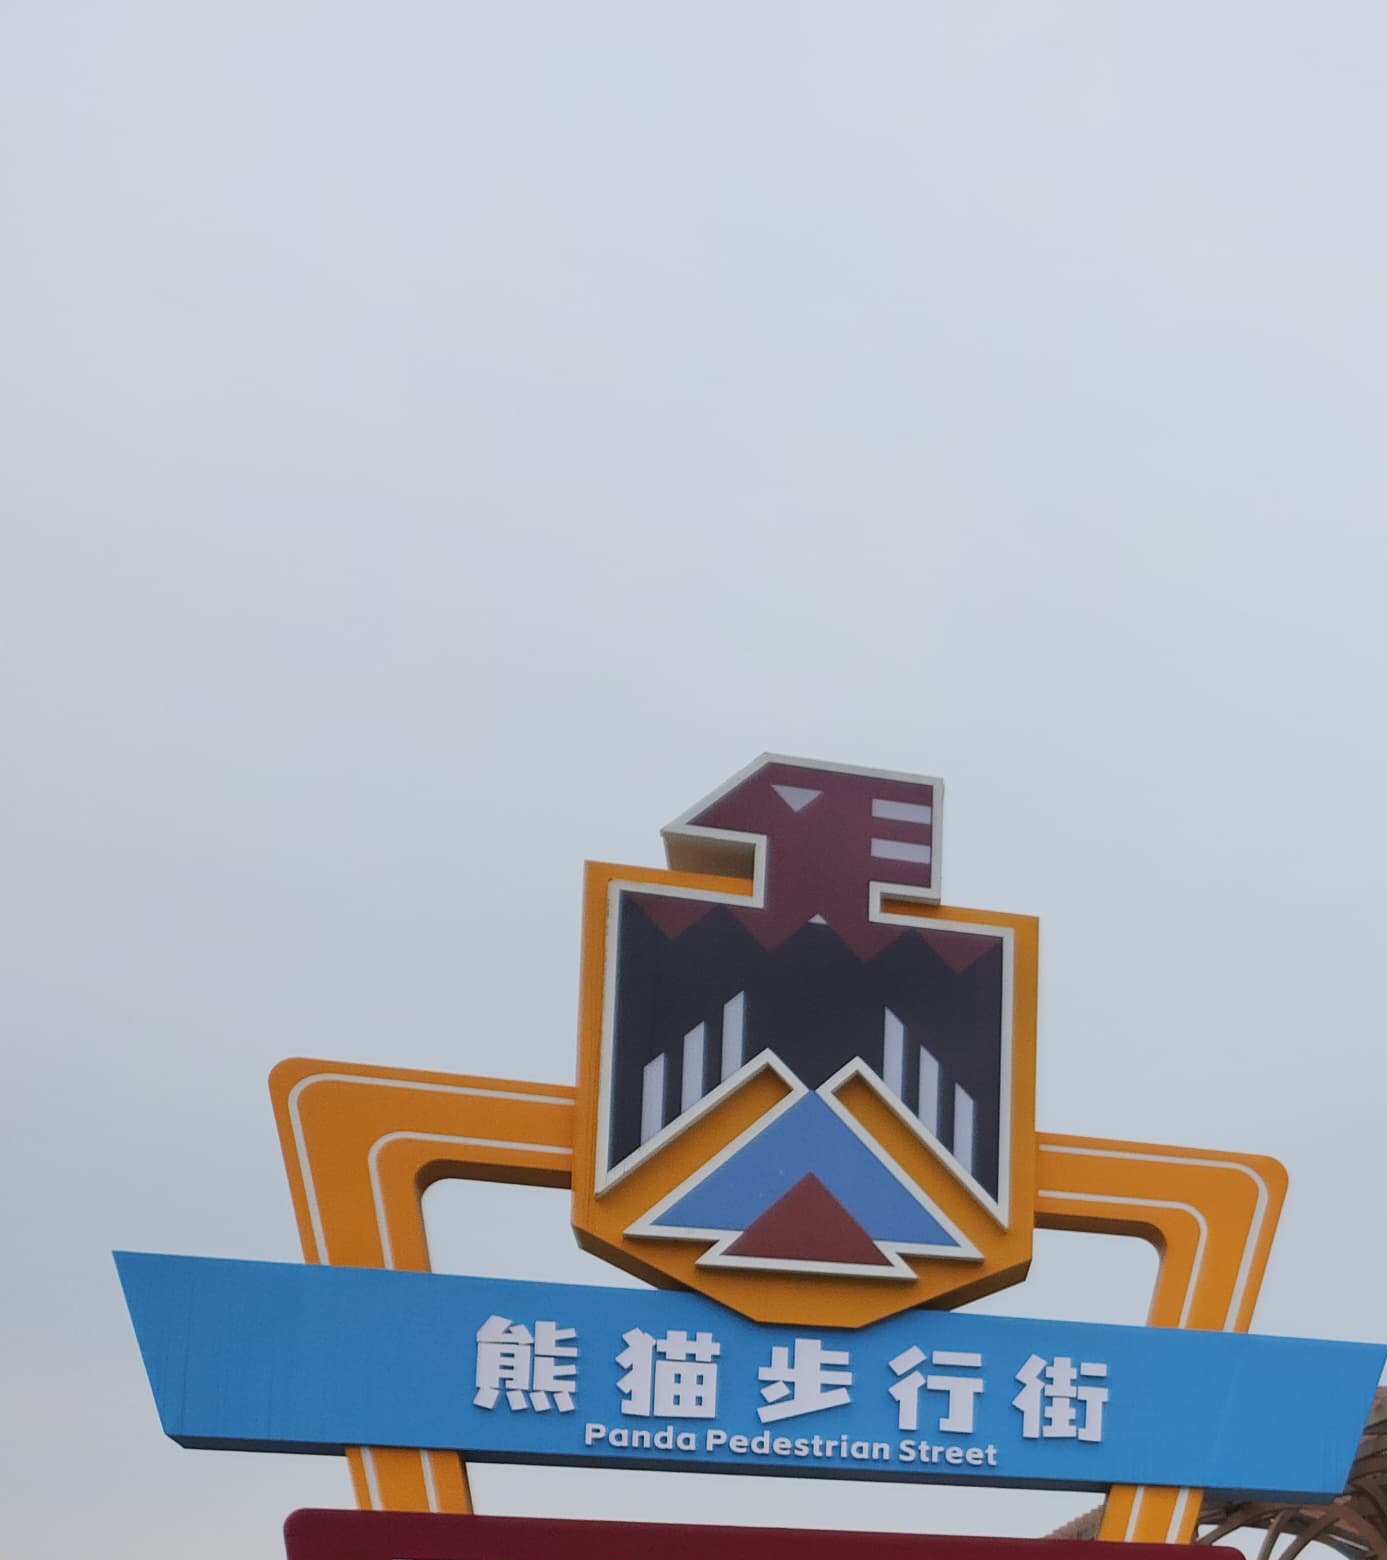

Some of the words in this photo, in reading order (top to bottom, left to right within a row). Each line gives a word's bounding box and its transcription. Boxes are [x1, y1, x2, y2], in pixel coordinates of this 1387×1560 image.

[474, 1314, 1110, 1443] 熊猫步行街
[584, 1423, 698, 1451] Panda
[707, 1429, 891, 1463] Pedestrian
[899, 1439, 998, 1467] Street
